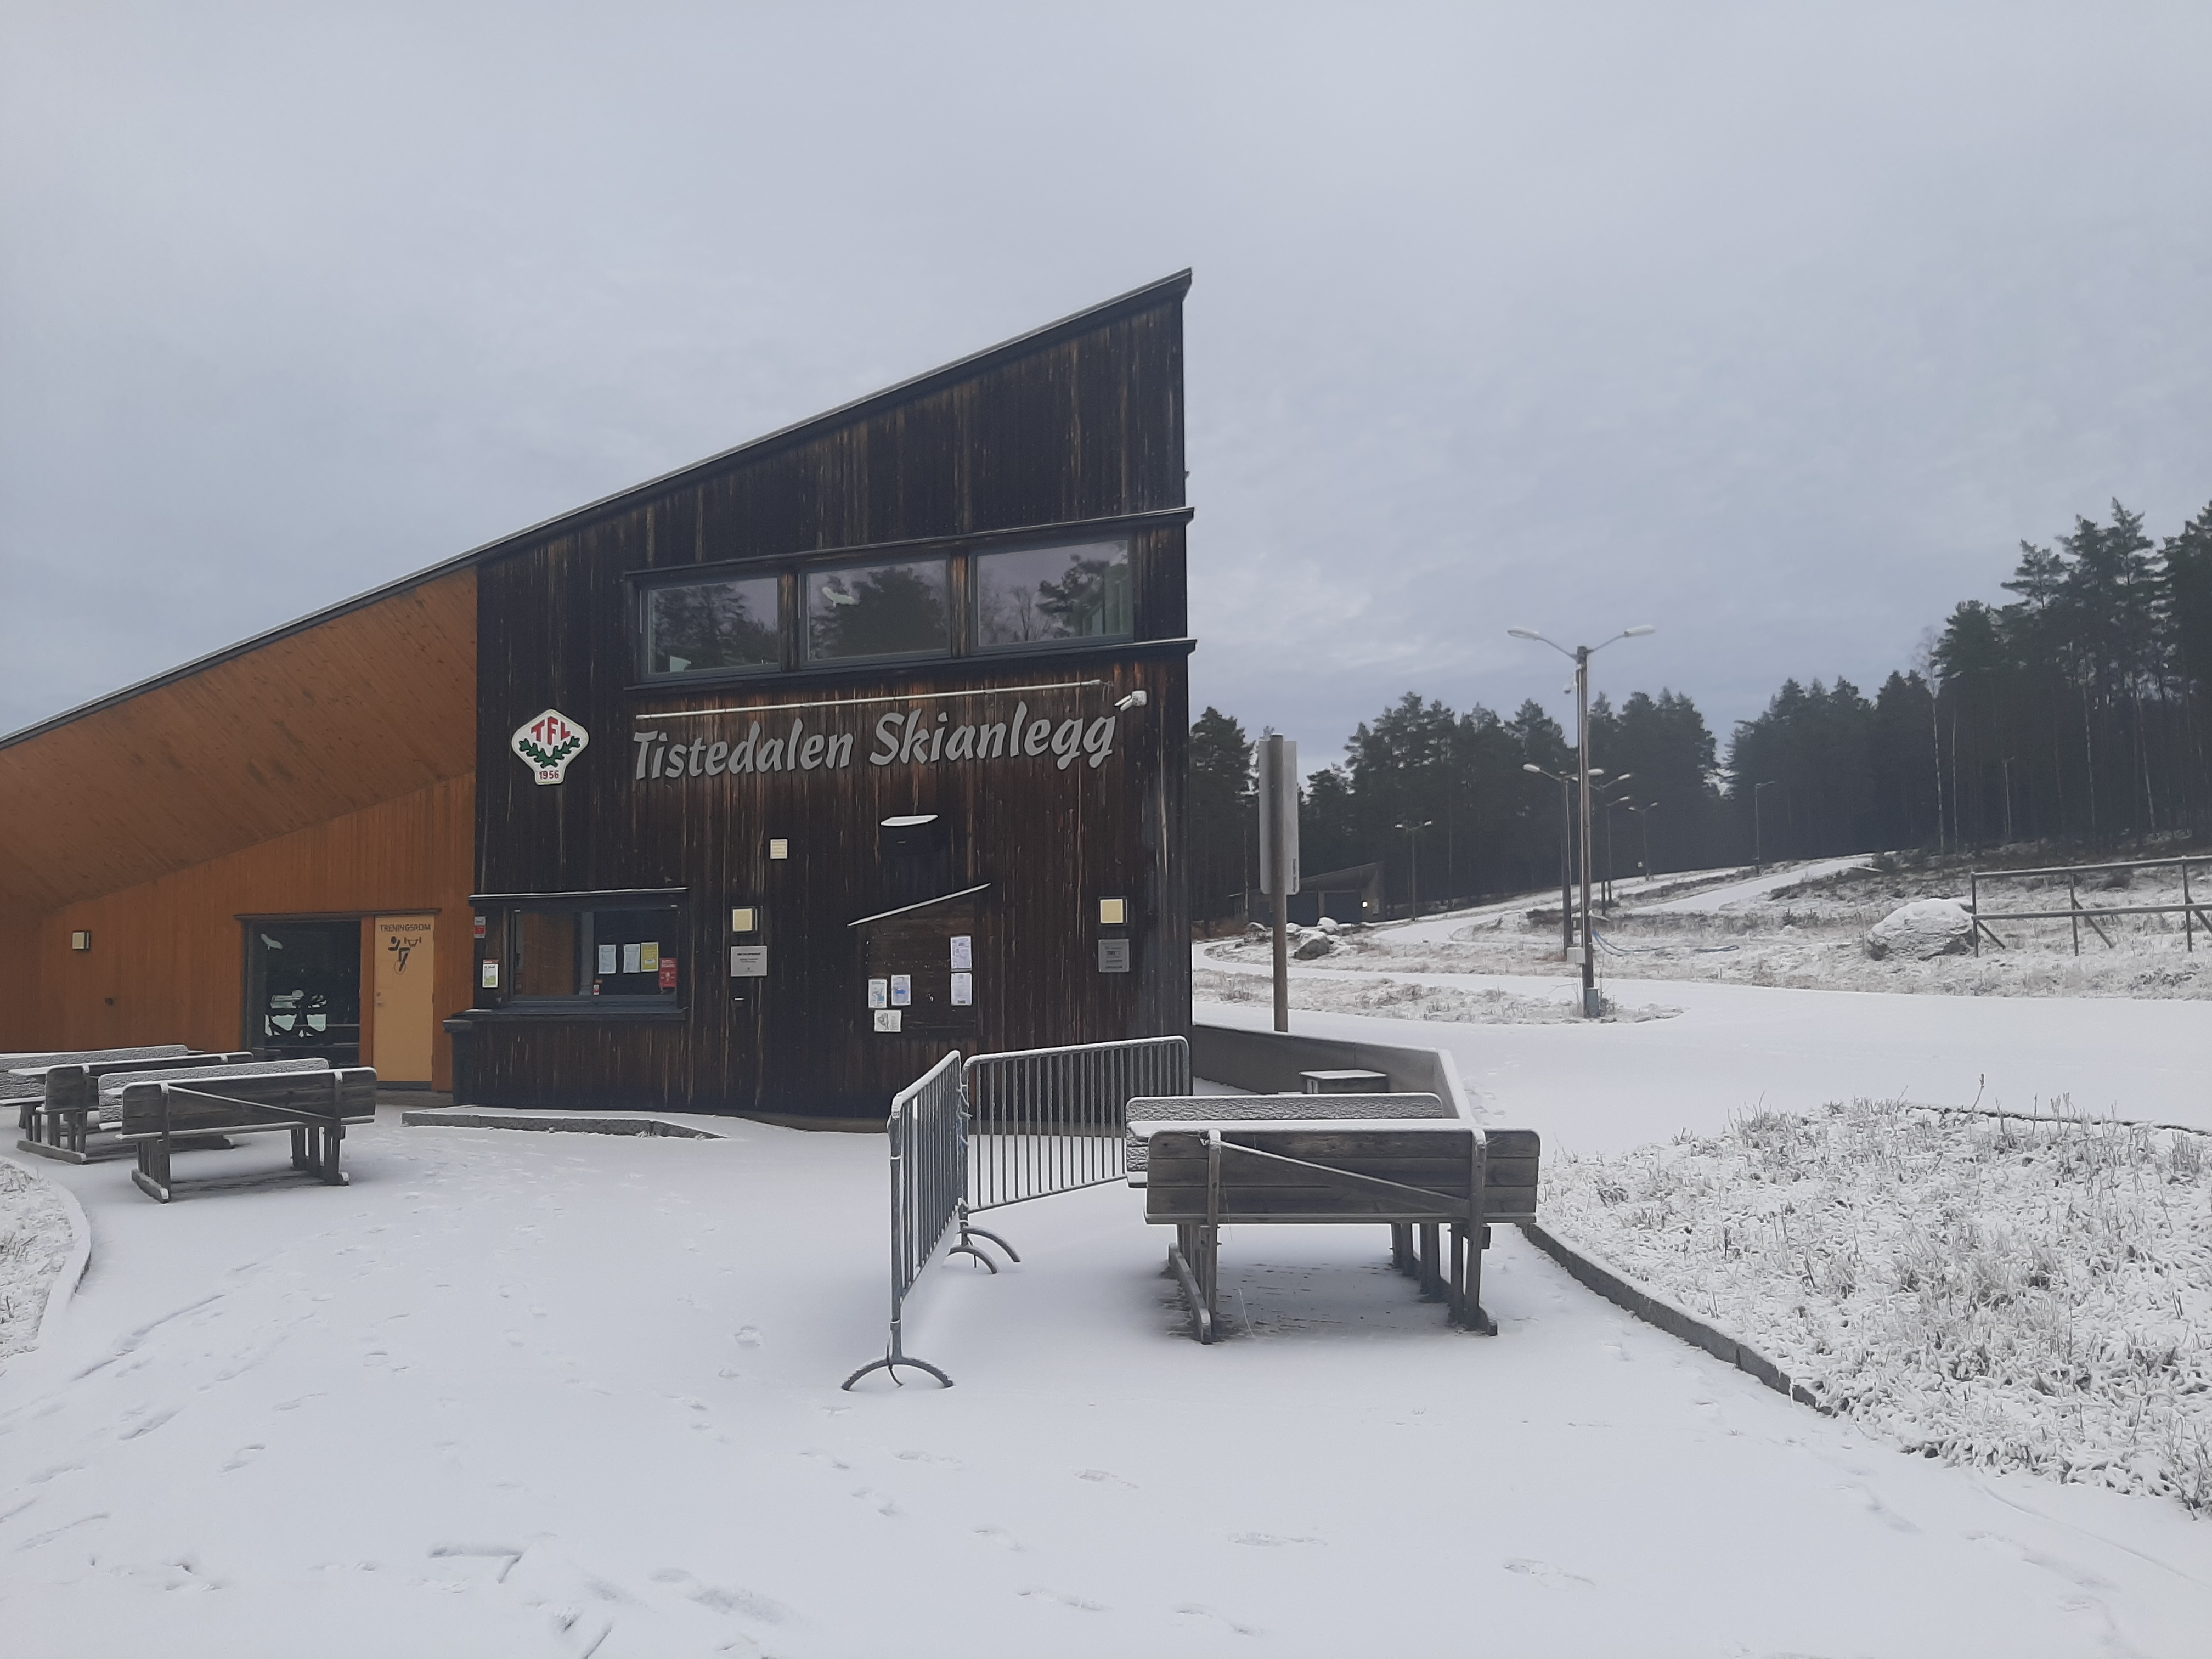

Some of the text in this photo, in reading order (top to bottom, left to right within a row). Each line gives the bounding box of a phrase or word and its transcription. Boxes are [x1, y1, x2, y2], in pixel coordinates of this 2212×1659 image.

[531, 716, 571, 746] TFL
[633, 701, 1116, 780] Tistedalen Skianlegg
[539, 770, 560, 780] 1956
[380, 923, 431, 932] TRENINGSROM
